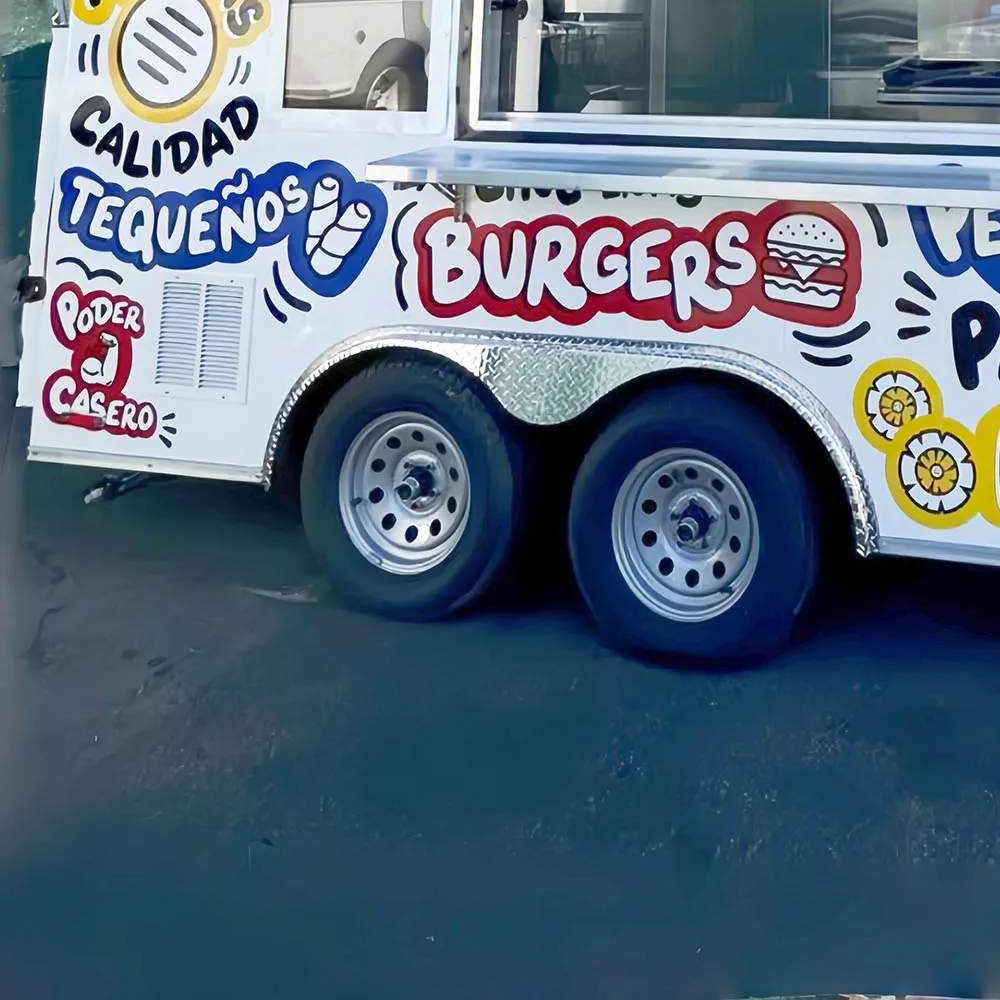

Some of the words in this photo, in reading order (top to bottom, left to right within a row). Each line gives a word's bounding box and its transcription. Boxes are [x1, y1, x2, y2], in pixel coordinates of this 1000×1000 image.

[70, 96, 258, 177] CALIDAD
[72, 174, 308, 263] TEQUEÑOS
[423, 216, 756, 321] BURGERS
[56, 290, 142, 342] PODER
[49, 375, 155, 431] CASERO
